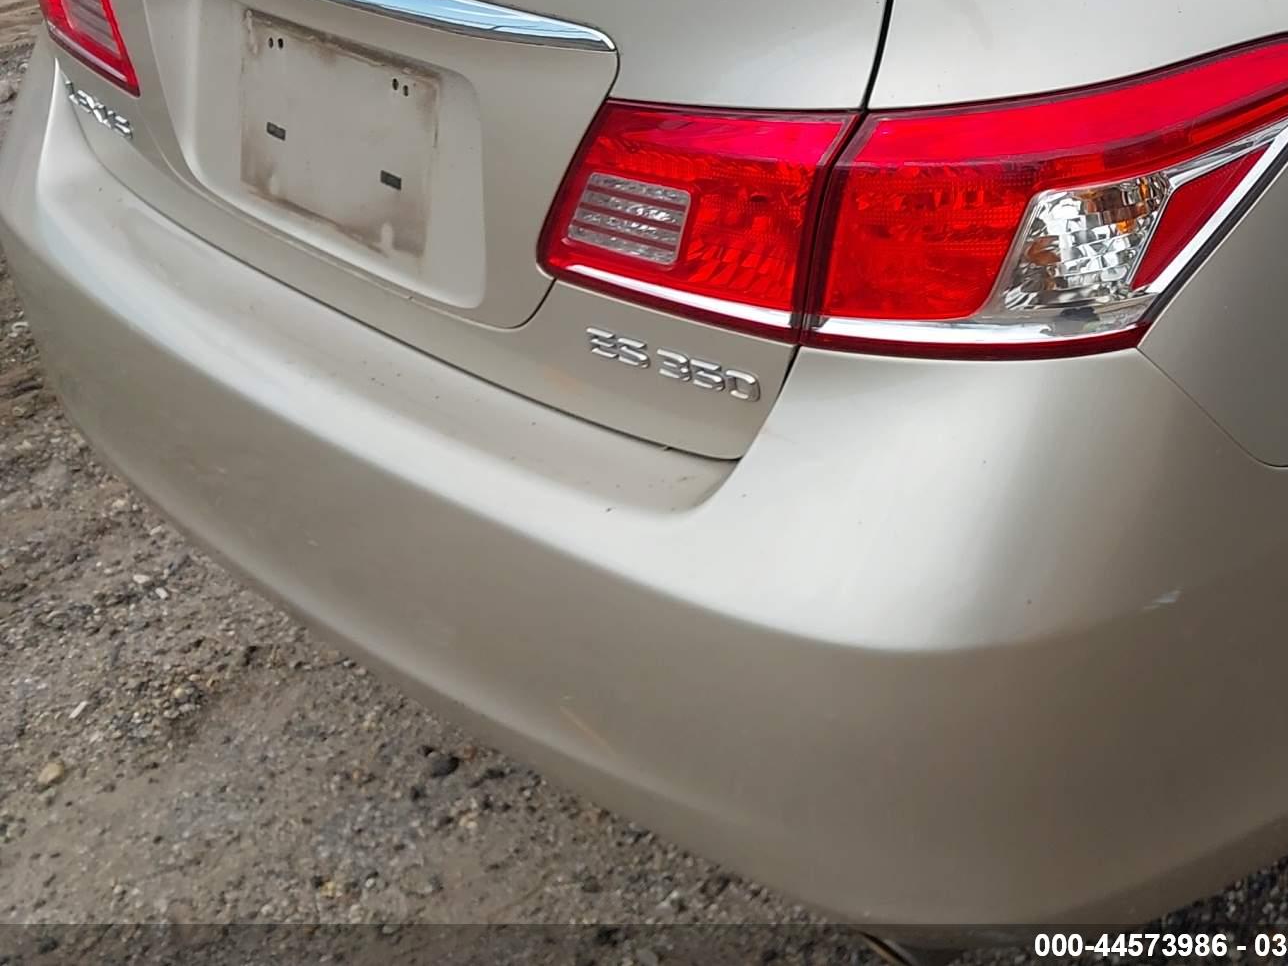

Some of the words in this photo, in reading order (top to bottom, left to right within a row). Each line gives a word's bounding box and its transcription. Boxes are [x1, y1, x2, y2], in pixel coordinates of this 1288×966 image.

[65, 80, 133, 138] LEXUS
[586, 327, 650, 369] ES
[656, 348, 761, 402] 350
